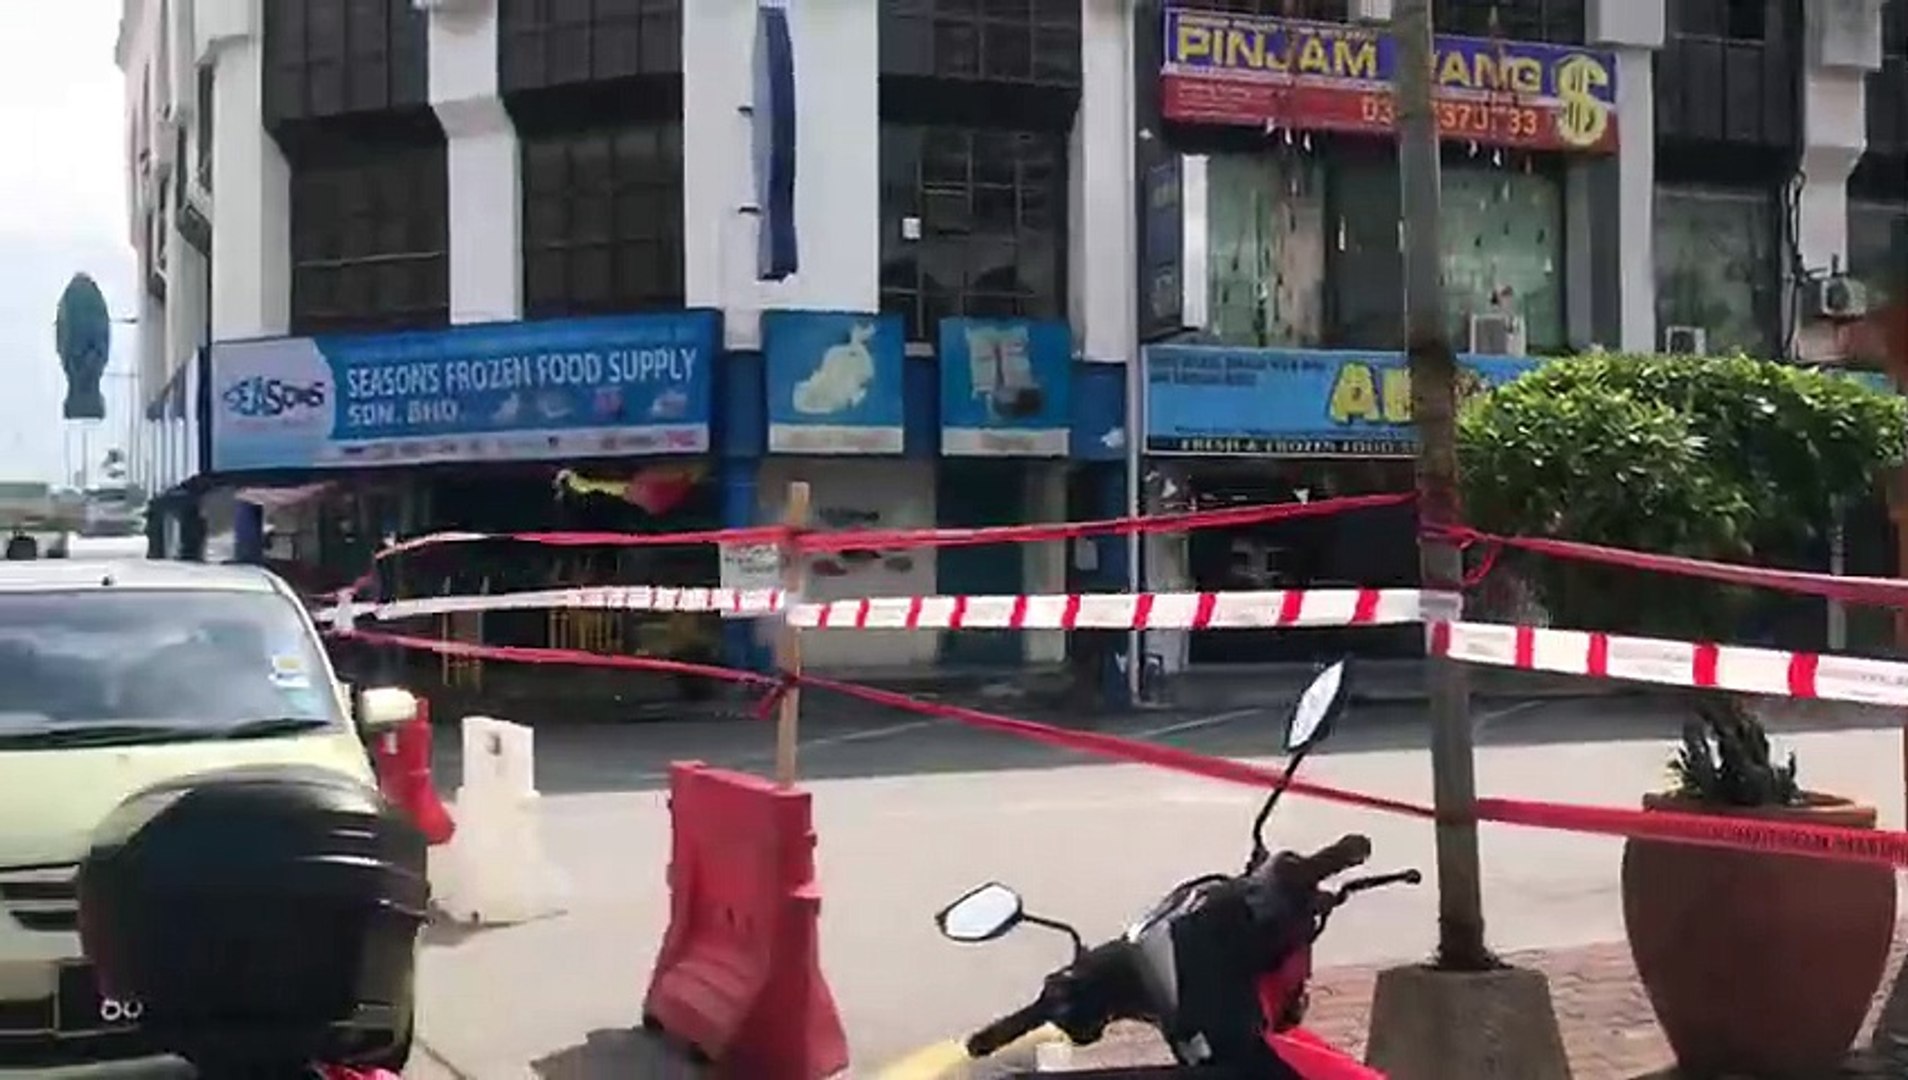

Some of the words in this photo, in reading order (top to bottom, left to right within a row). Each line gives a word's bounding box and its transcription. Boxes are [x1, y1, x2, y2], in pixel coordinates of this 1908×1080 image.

[445, 355, 532, 392] FROZEN
[535, 353, 600, 388] FOOD
[608, 348, 697, 384] SUPPLY
